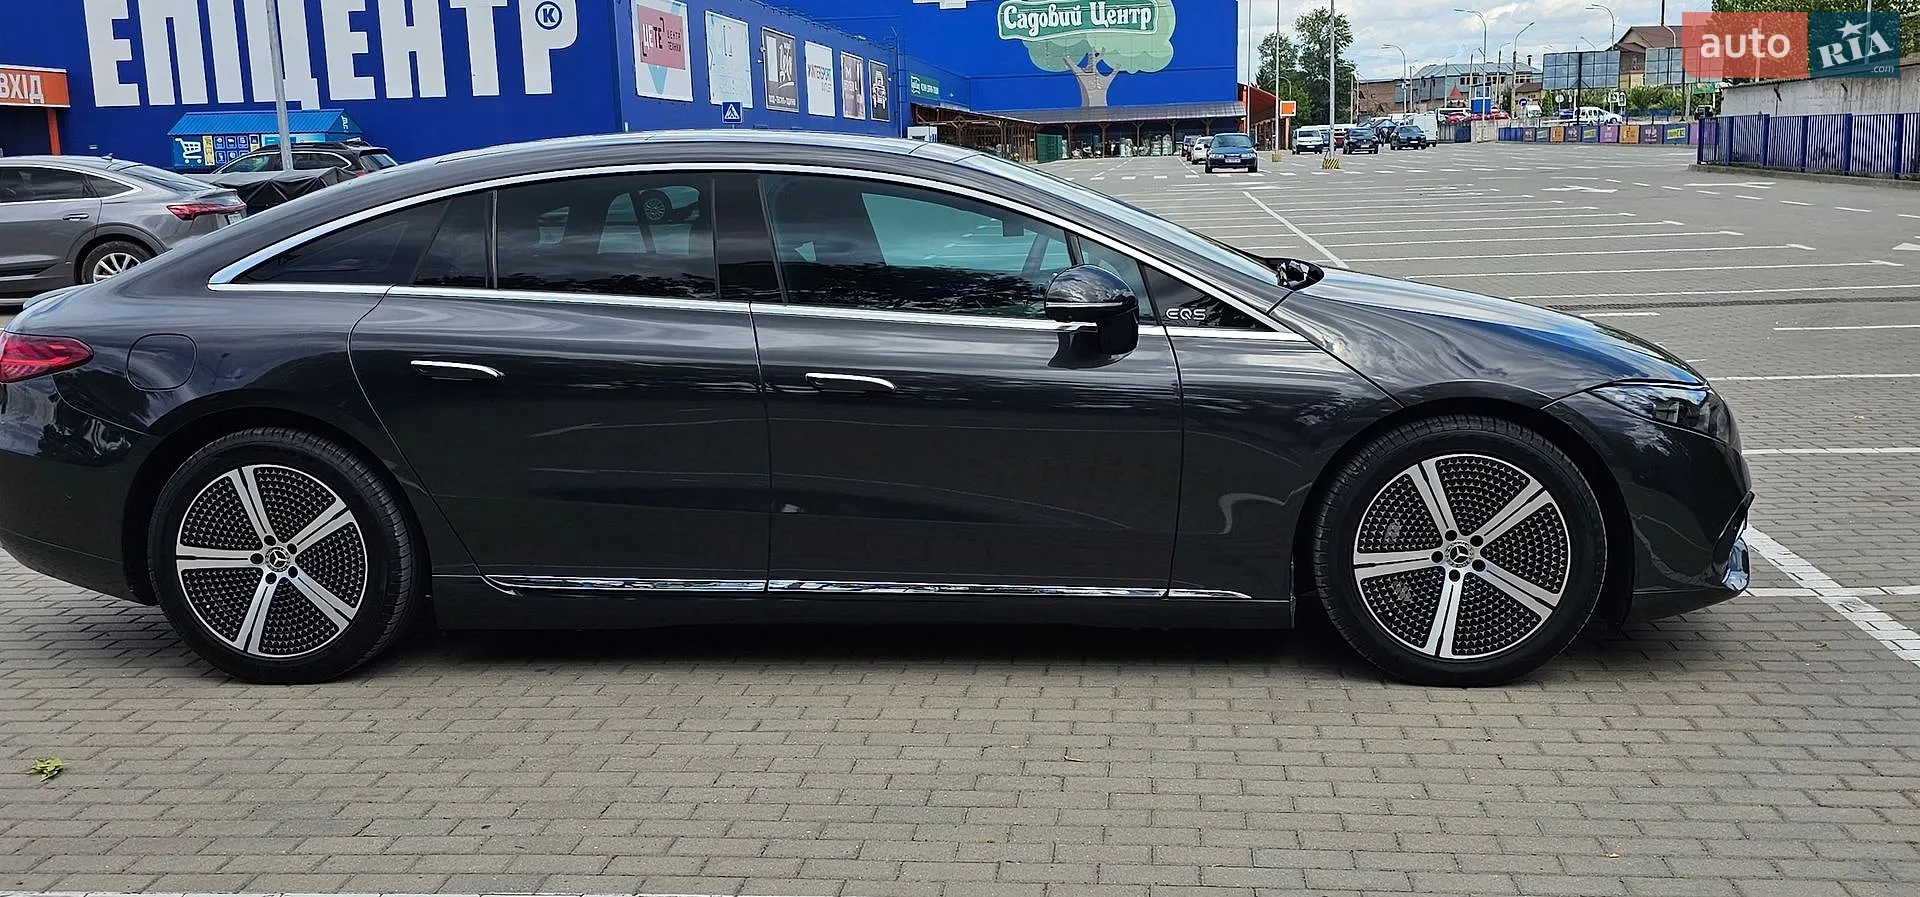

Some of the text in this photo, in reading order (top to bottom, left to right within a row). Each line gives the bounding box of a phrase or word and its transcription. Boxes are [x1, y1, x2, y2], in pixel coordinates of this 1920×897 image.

[1003, 1, 1151, 37] Садовий Центр
[83, 0, 577, 110] ЕПІЦЕНТР
[0, 73, 45, 104] ВХІД
[1166, 308, 1206, 320] EQS
